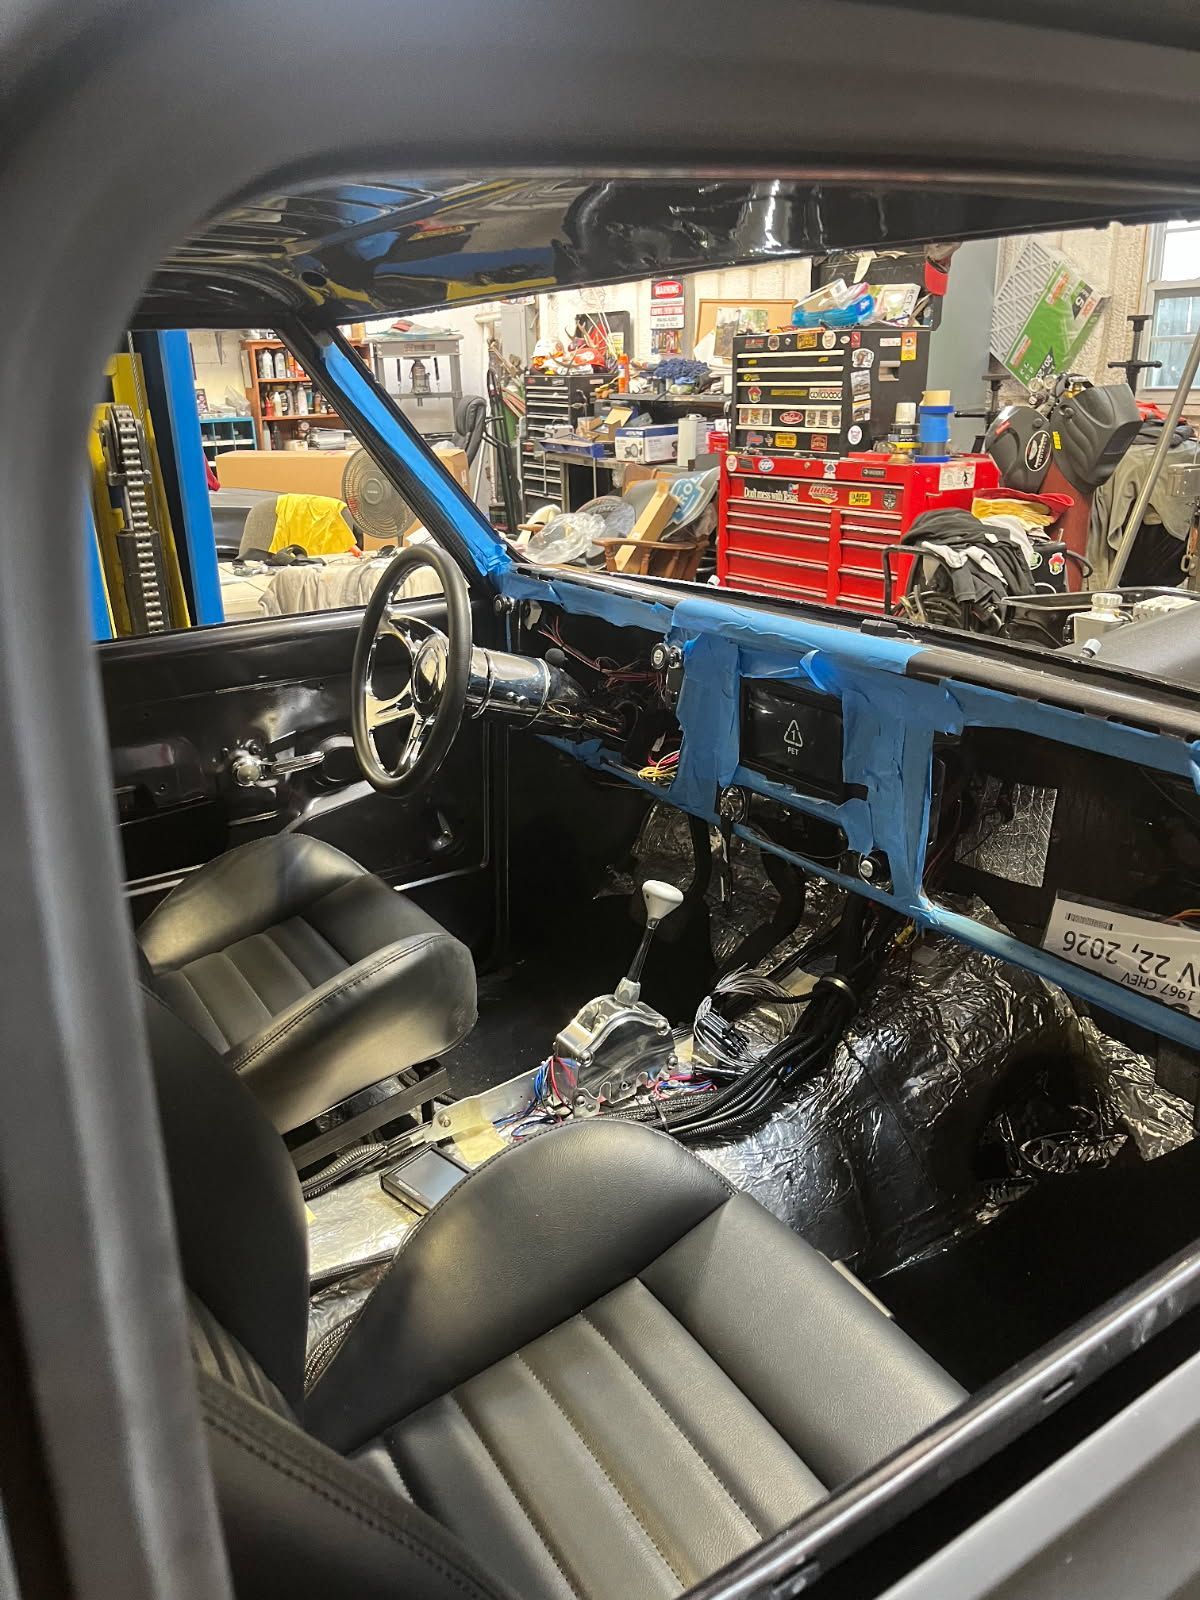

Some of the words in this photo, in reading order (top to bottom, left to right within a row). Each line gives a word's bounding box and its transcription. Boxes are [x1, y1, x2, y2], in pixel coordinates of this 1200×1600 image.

[787, 747, 799, 756] PET
[1062, 930, 1122, 965] 2026
[1132, 943, 1171, 979] 22,
[1120, 971, 1157, 991] CHEV
[1159, 984, 1195, 1002] 1967
